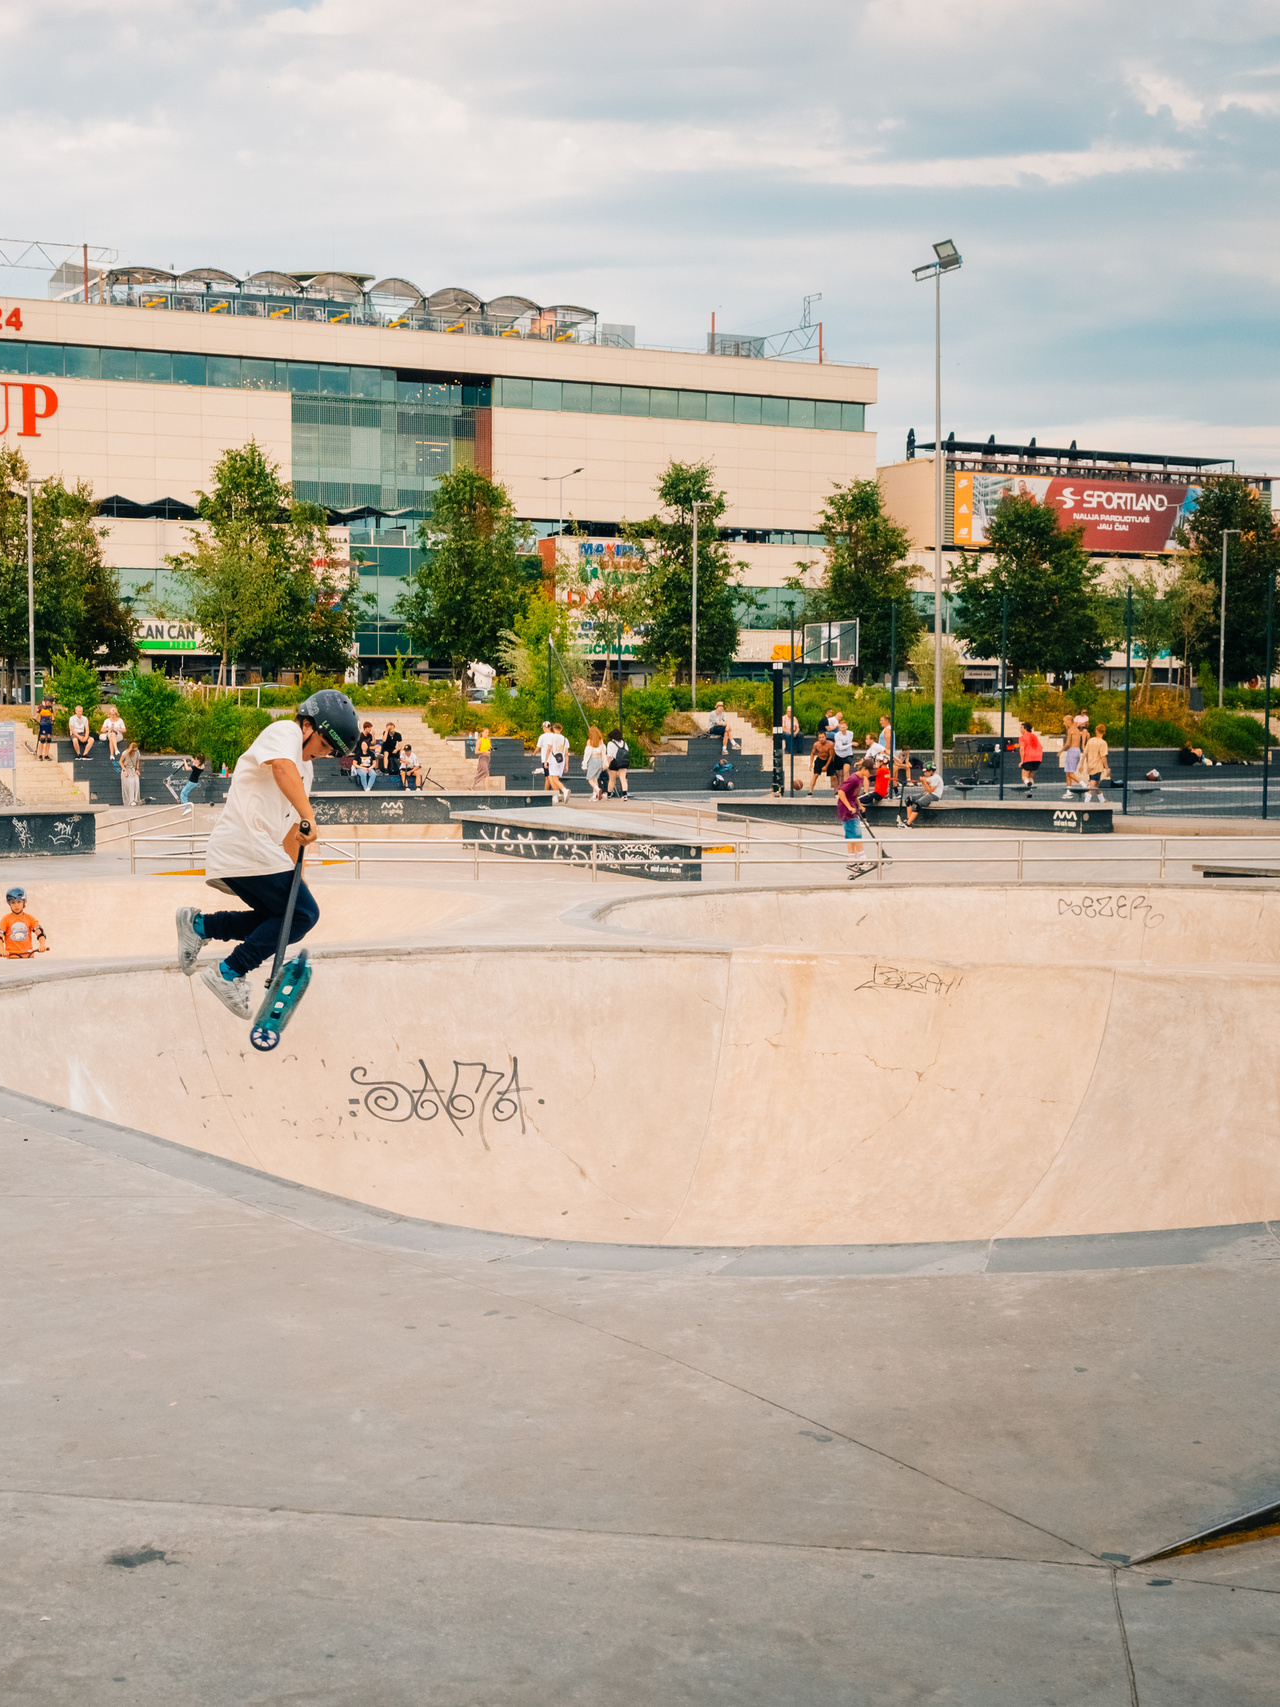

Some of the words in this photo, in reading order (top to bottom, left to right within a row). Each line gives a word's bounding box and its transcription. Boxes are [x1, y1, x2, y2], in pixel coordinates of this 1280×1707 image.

[1082, 490, 1168, 512] SPORTLAND
[1073, 512, 1099, 521] NAUJA
[1100, 514, 1150, 523] PARDUOTUVĖ
[137, 624, 164, 639] CAN
[167, 624, 195, 639] CAN
[169, 641, 194, 649] PIZZA
